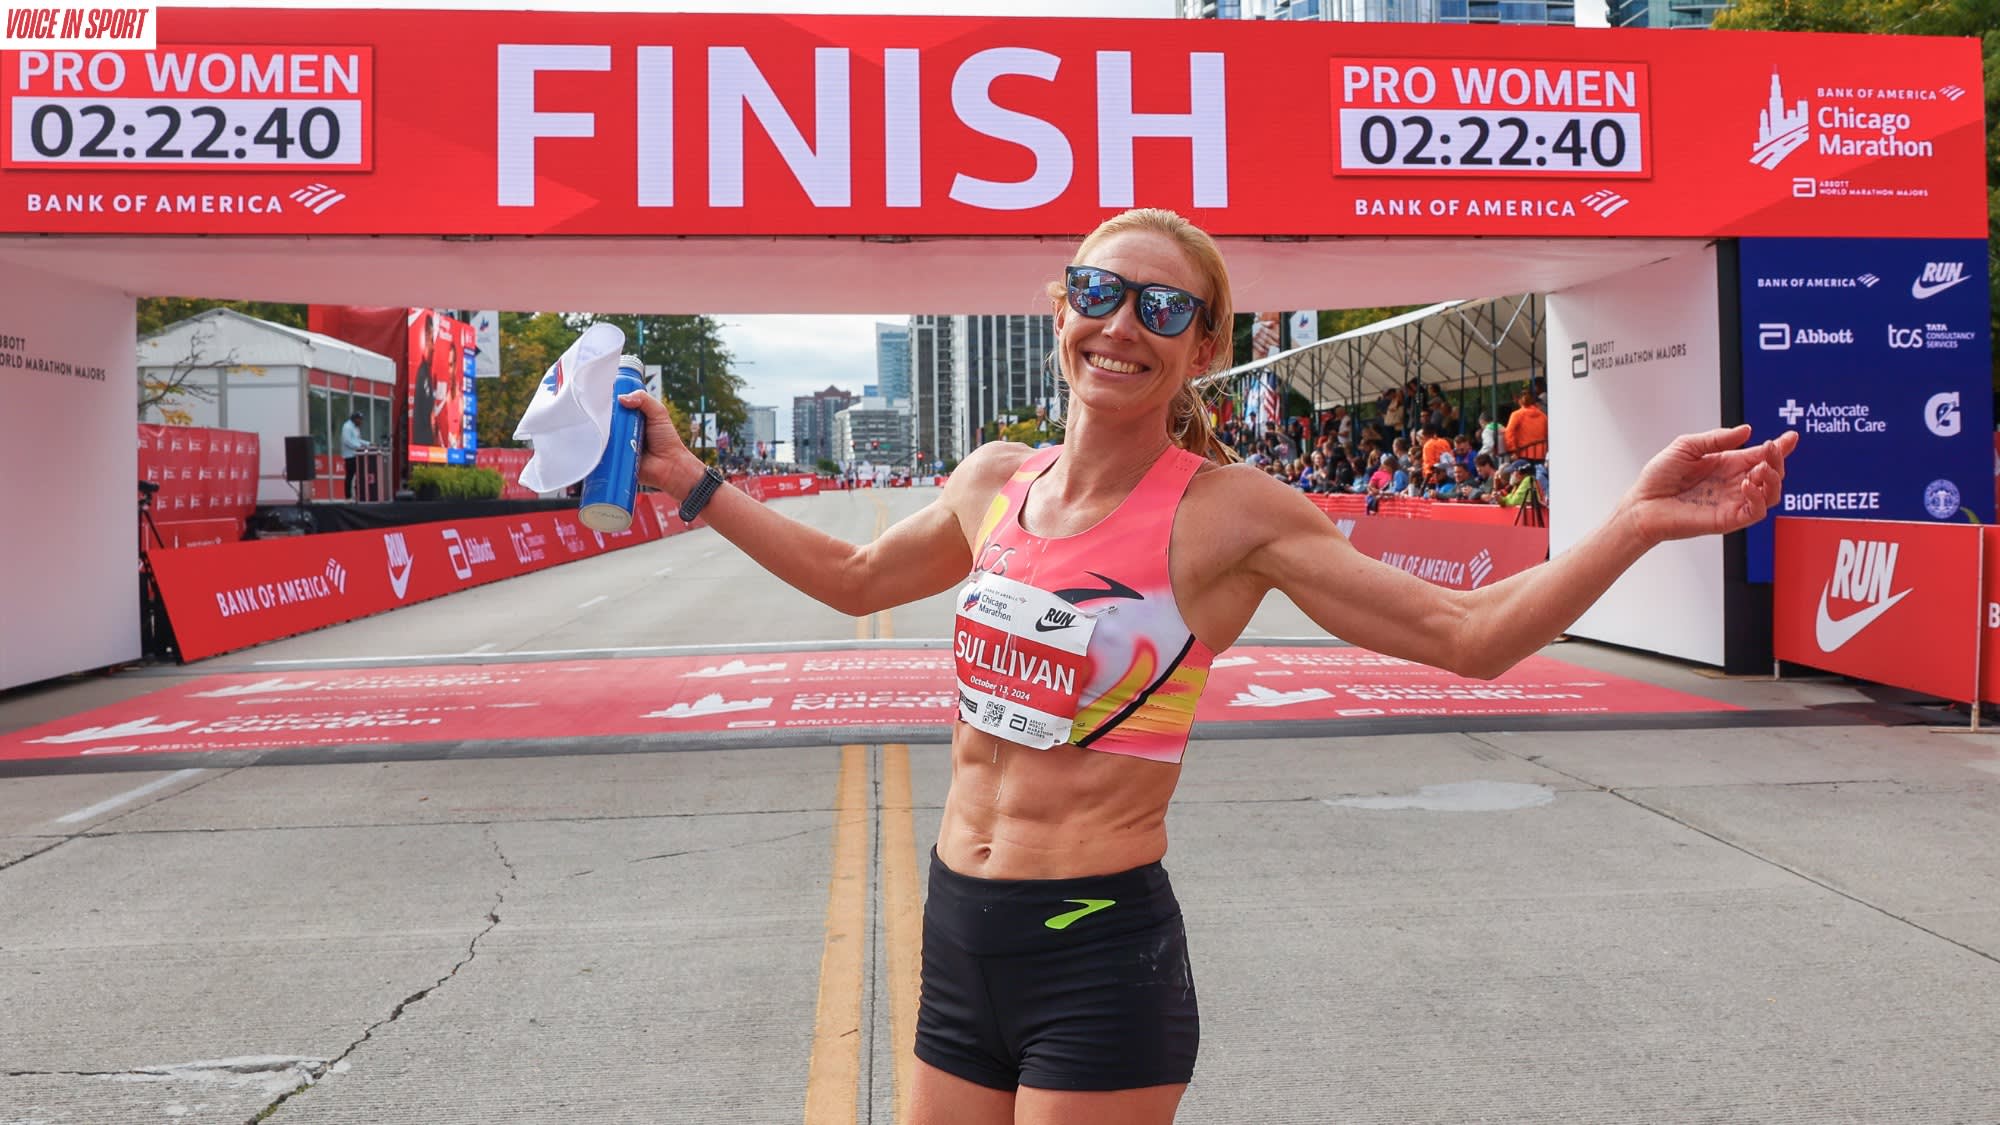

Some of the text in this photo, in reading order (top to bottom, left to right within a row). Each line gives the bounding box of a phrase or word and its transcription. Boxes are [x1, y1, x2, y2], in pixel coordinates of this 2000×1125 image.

[19, 51, 358, 94] PRO WOMEN
[1343, 66, 1636, 107] PRO WOMEN
[1817, 88, 1936, 100] BANK OF AMERICA
[31, 104, 340, 159] 02:22:40
[497, 43, 1228, 210] FINISH
[1818, 106, 1910, 135] Chicago
[1360, 115, 1626, 167] 02:22:40
[1819, 134, 1933, 157] Marathon
[28, 194, 283, 214] BANK OF AMERICA
[1355, 199, 1576, 217] BANK OF AMERICA
[1758, 278, 1856, 287] BANK OF AMERICA
[1922, 262, 1963, 282] RUN
[0, 335, 25, 351] BOTT
[1794, 329, 1854, 344] Abbott
[1888, 324, 1923, 348] tcs
[1926, 332, 1975, 340] CONSULTANCY
[1926, 340, 1958, 348] SERVICES
[0, 353, 106, 381] ORLD MARATHON MAJORS
[1615, 351, 1653, 367] MARATHON
[1656, 344, 1687, 360] MAJORS
[1806, 402, 1869, 417] Advocate
[1806, 418, 1886, 433] Health Care
[384, 532, 410, 567] RUN
[1417, 558, 1465, 585] AMERICA
[1831, 539, 1899, 603] RUN
[216, 575, 331, 617] BANK OF AMERICA
[982, 594, 1008, 610] Chicago
[979, 603, 1012, 621] Marathon
[1044, 607, 1077, 627] RUN
[956, 630, 1075, 696] SULLIVAN
[970, 675, 1031, 701] October 13, 2024
